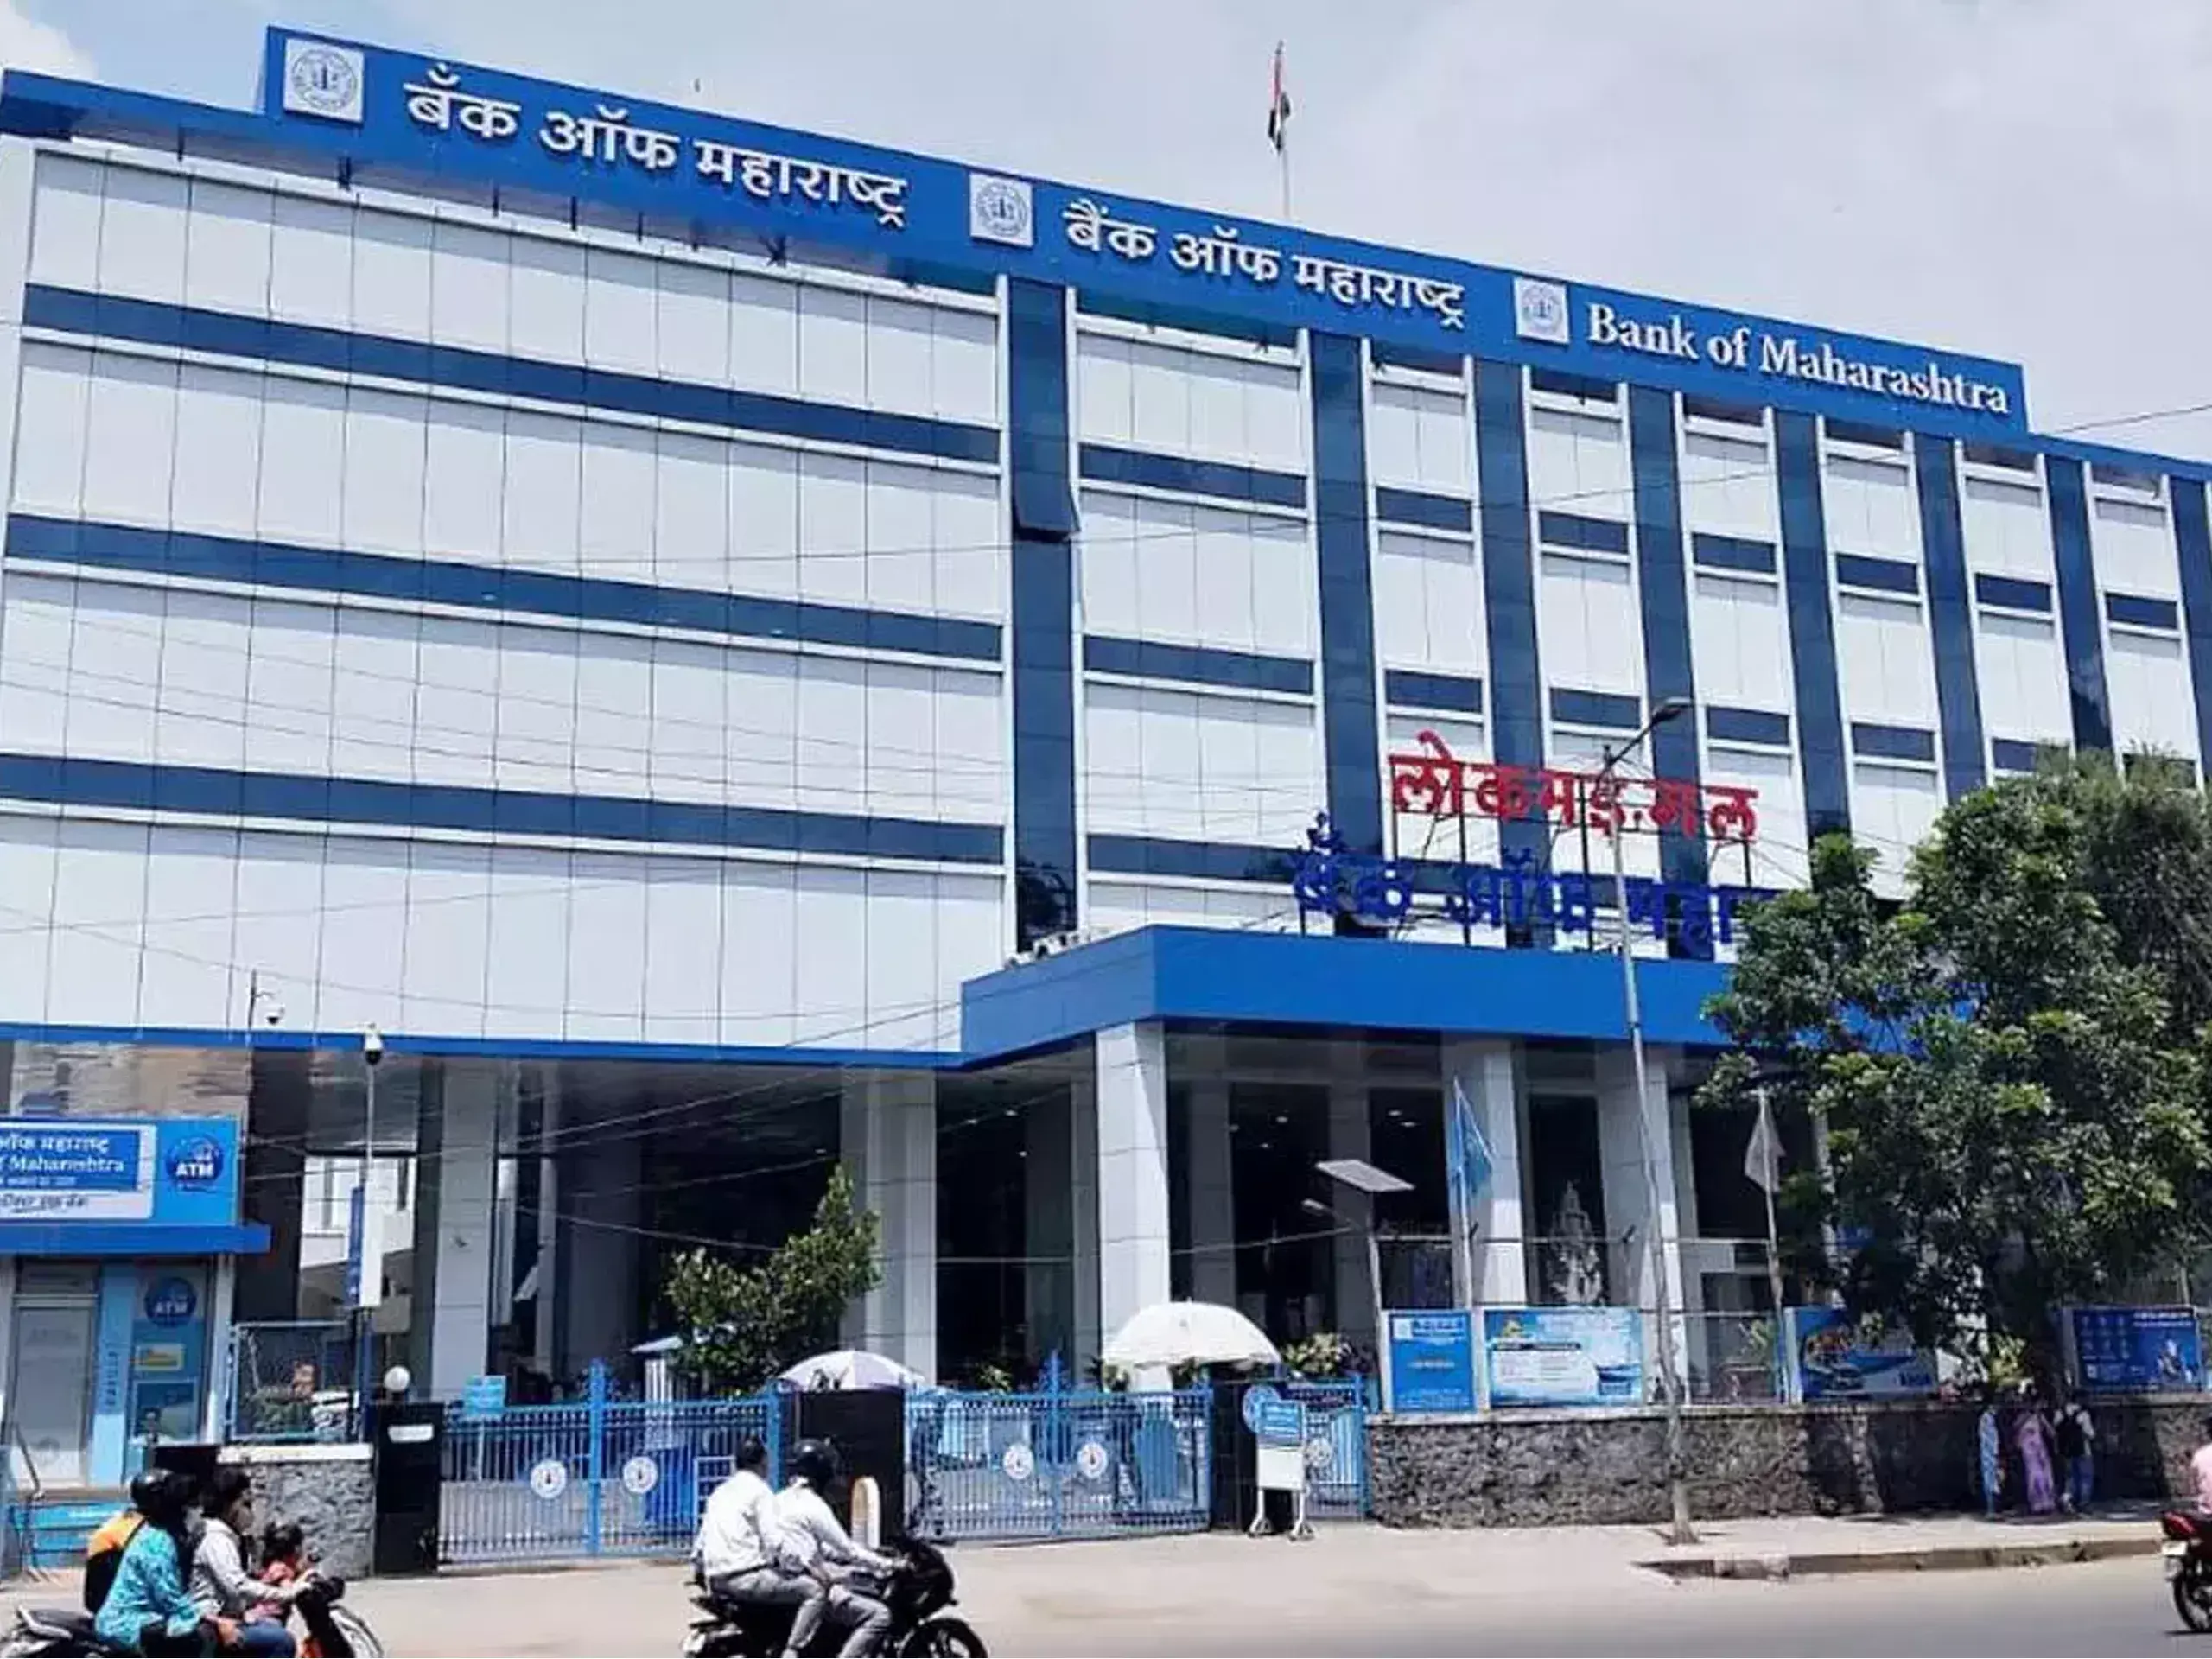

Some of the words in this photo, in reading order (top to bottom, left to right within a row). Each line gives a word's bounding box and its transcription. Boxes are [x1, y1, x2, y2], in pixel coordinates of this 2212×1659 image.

[404, 63, 521, 138] बँक
[539, 104, 679, 170] ऑफ
[692, 138, 907, 227] महाराष्ट्र
[1062, 197, 1157, 259] बैंक
[1170, 224, 1281, 282] ऑफ
[1292, 253, 1465, 329] महाराष्ट्र
[1585, 302, 1700, 360] Bank
[1707, 327, 1751, 366] of
[1759, 334, 2011, 415] Maharashtra
[175, 1162, 214, 1178] ATM
